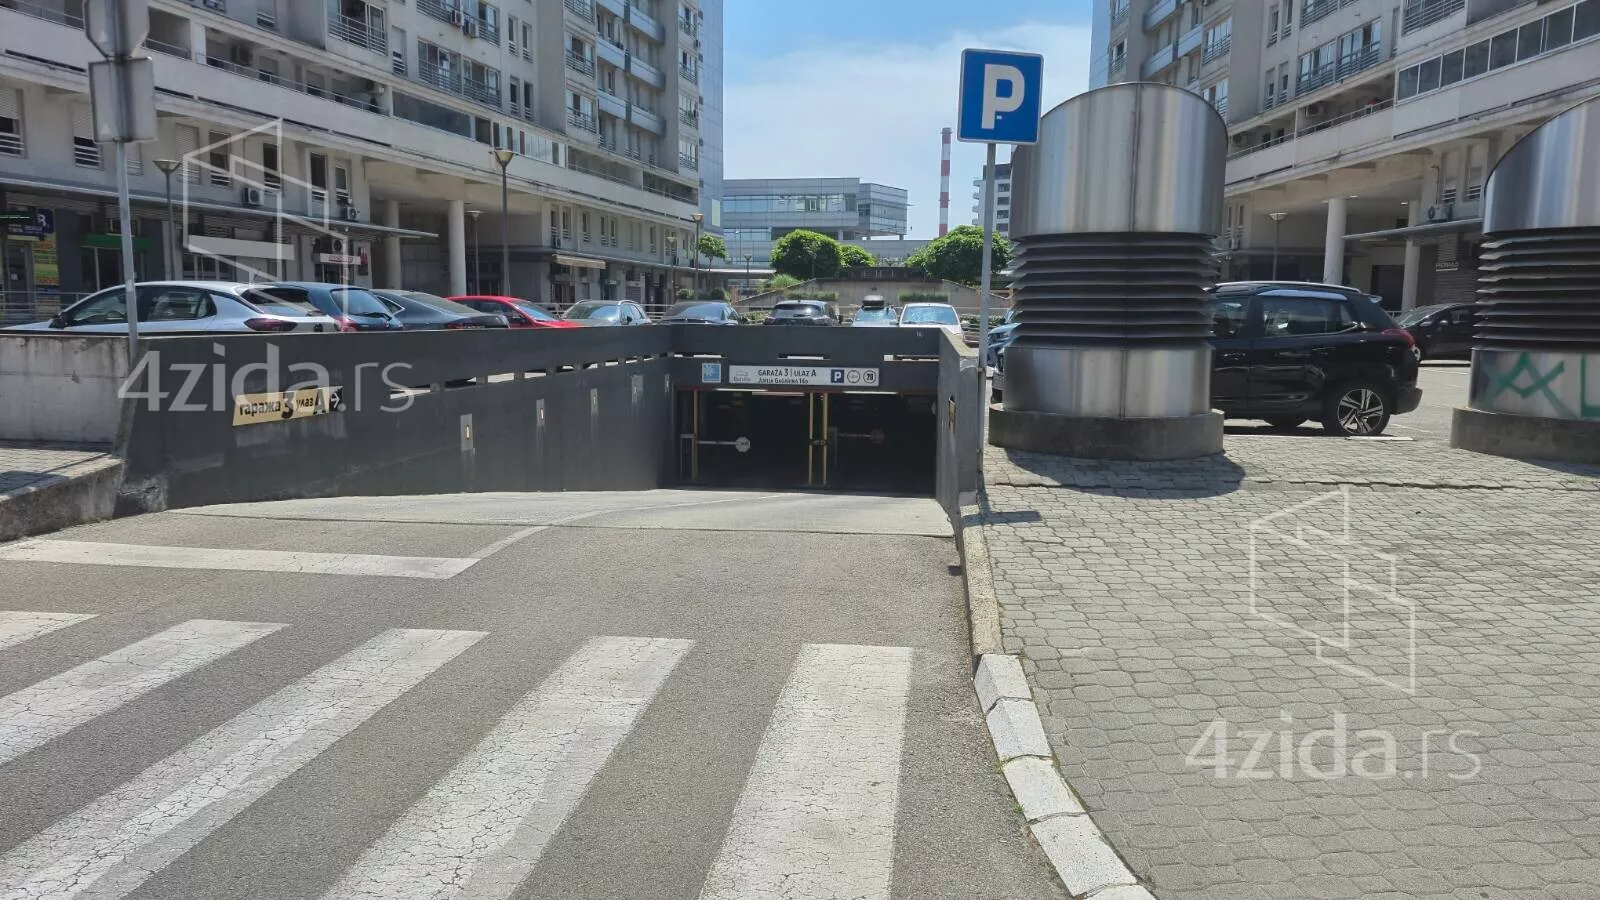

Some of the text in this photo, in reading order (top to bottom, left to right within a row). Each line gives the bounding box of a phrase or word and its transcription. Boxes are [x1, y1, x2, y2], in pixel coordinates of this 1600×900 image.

[981, 63, 1025, 130] P
[784, 368, 789, 377] 3
[794, 369, 809, 377] ULAZ
[811, 369, 817, 377] A
[834, 371, 842, 382] P
[239, 400, 281, 417] гаража
[281, 391, 295, 419] 3
[296, 397, 314, 411] улаз
